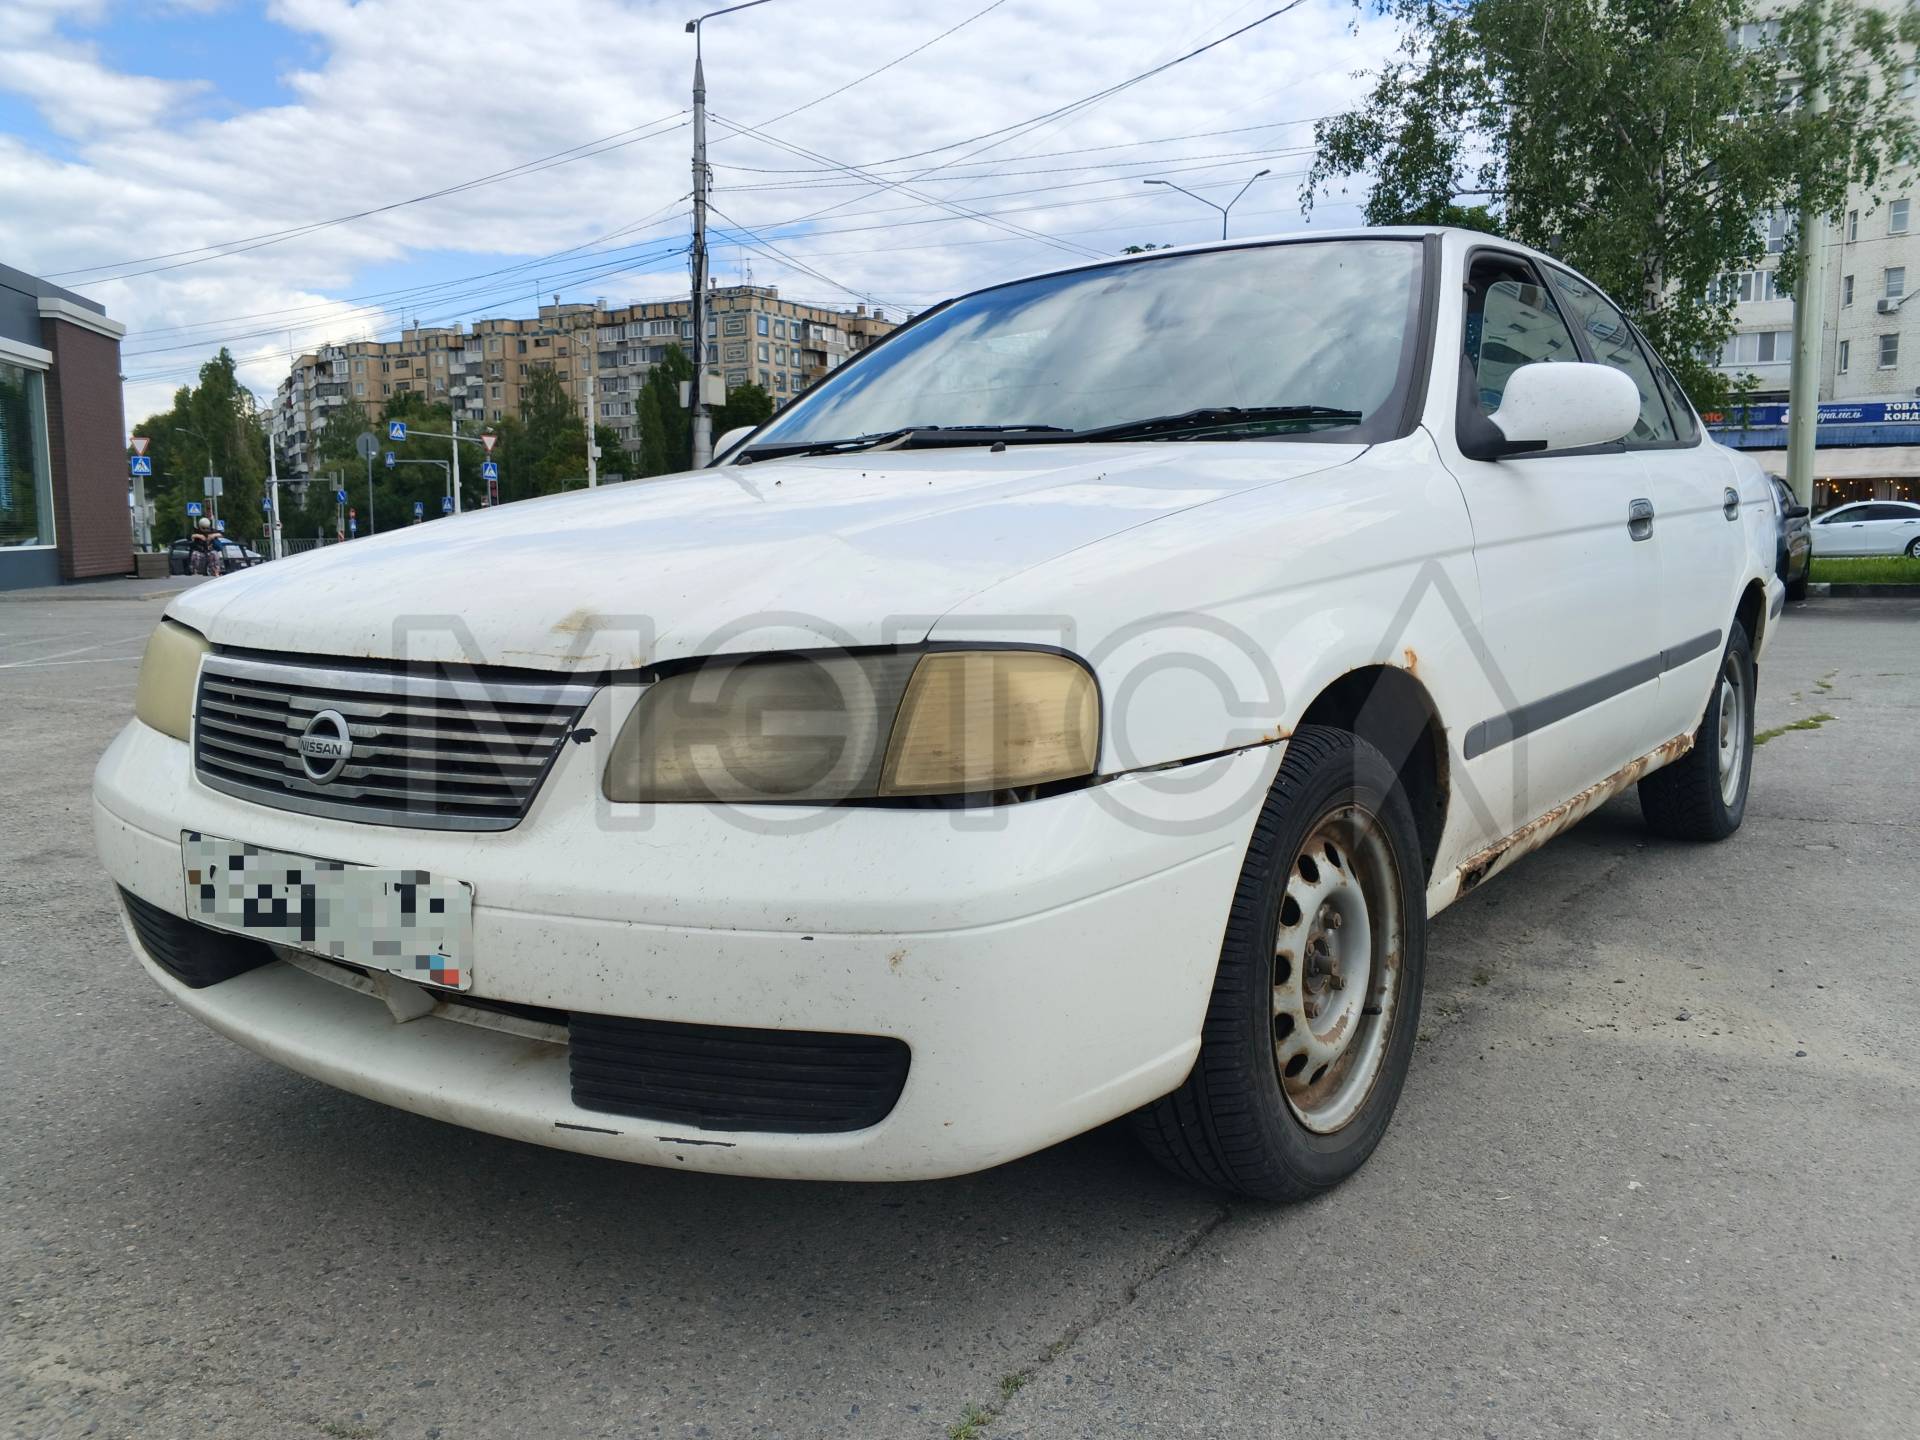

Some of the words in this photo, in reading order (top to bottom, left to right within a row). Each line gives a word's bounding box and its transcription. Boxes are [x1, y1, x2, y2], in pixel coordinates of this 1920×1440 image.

[1885, 402, 1920, 411] ТОВА
[1884, 412, 1920, 421] КОНД
[300, 740, 342, 756] NISSAN
